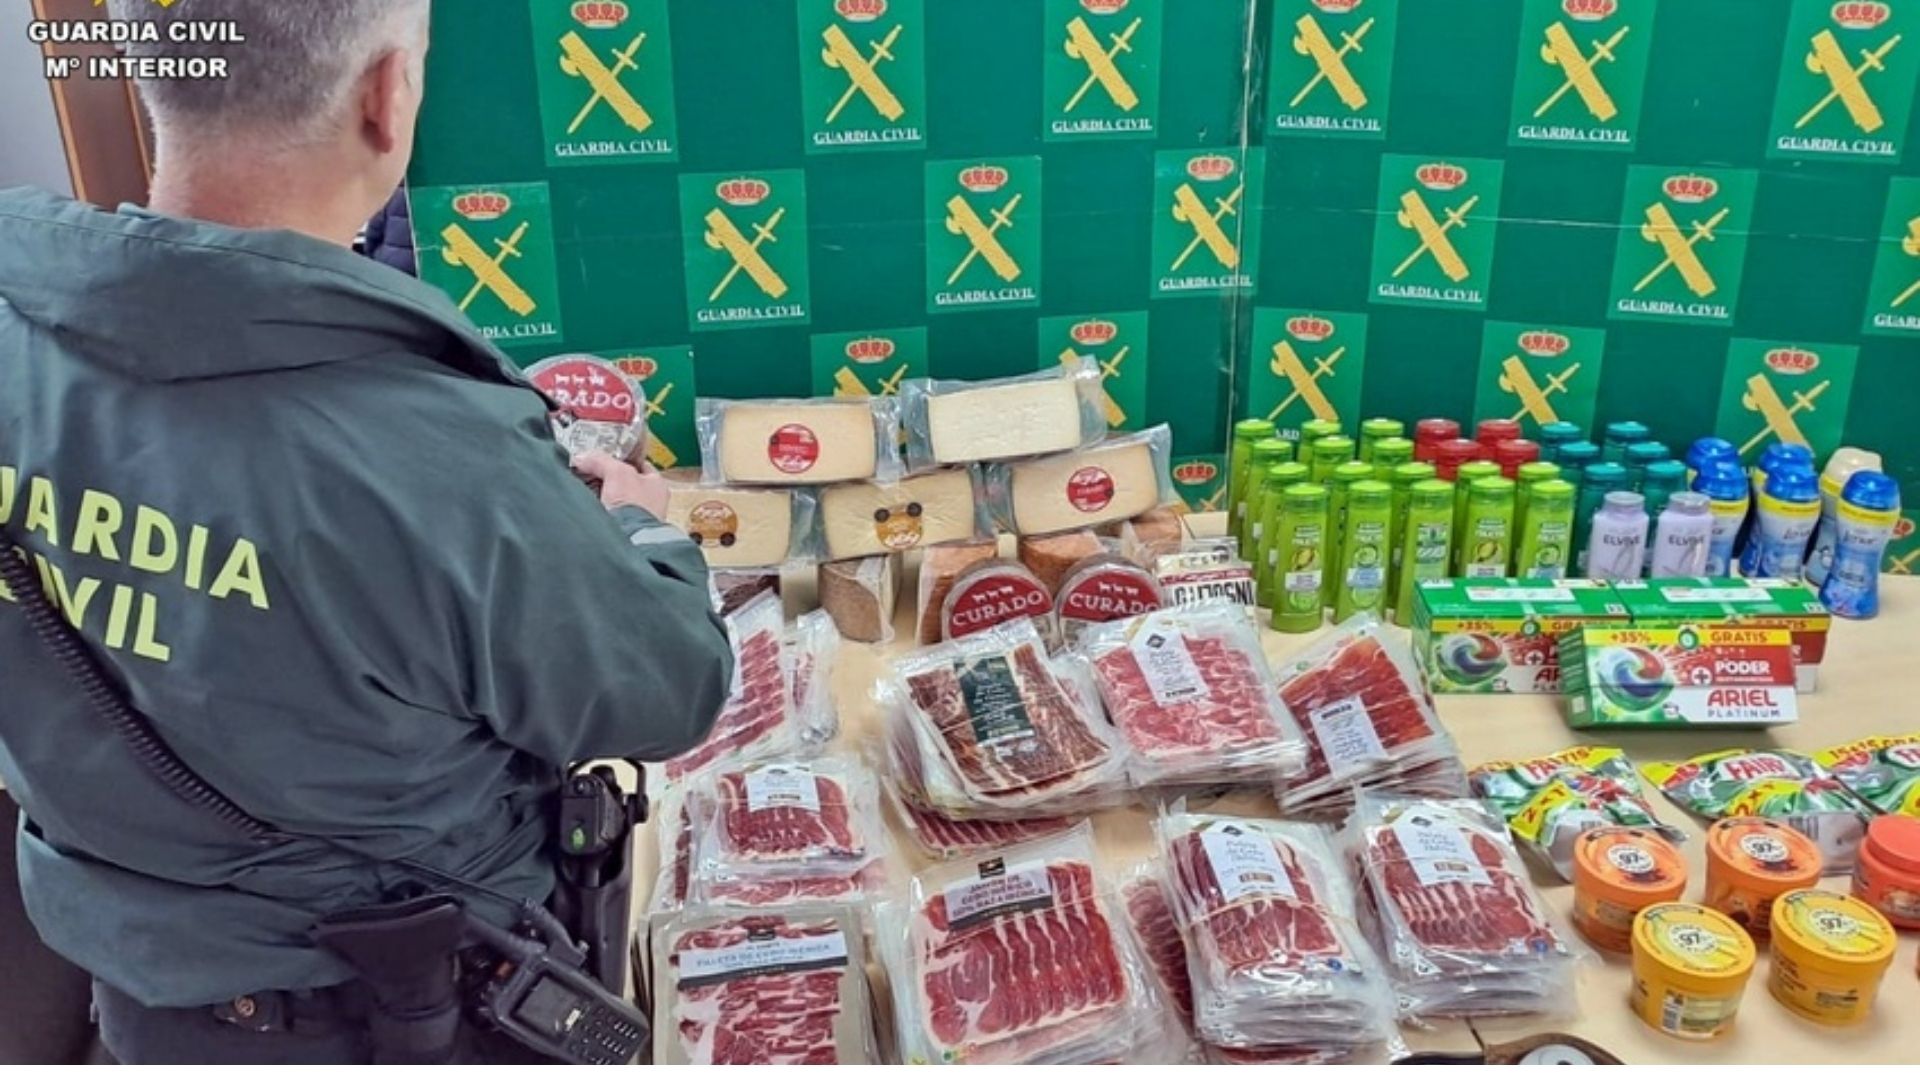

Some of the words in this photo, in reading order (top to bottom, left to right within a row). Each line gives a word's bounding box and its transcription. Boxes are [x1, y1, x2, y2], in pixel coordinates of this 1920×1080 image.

[1052, 120, 1114, 133] GUARDIA
[1115, 118, 1152, 131] CIVIL
[1277, 116, 1339, 129] GUARDIA
[1343, 119, 1380, 131] CIVIL
[813, 130, 880, 145] GUARDIA
[882, 129, 920, 142] CIVIL
[1518, 127, 1586, 140] GUARDIA
[1589, 129, 1629, 143] CIVIL
[555, 142, 627, 156] GUARDIA
[630, 140, 671, 153] CIVIL
[1778, 137, 1849, 152] GUARDIA
[1852, 141, 1895, 155] CIVIL
[1159, 277, 1218, 290] GUARDIA
[935, 291, 997, 305] GUARDIA
[998, 288, 1035, 300] CIVIL
[1379, 284, 1441, 300] GUARDIA
[1443, 290, 1481, 302] CIVIL
[697, 308, 763, 321] GUARDIA
[765, 305, 804, 318] CIVIL
[1618, 300, 1684, 314] GUARDIA
[1687, 305, 1727, 318] CIVIL
[514, 323, 556, 337] CIVIL
[546, 388, 631, 410] RADO
[952, 590, 1044, 627] CURADO
[1069, 591, 1159, 614] CURADO
[1611, 632, 1651, 643] +35%
[1711, 632, 1769, 643] GRATIS
[1714, 660, 1770, 674] PODER
[1707, 690, 1779, 707] ARIEL
[1708, 710, 1781, 718] PLATINUM
